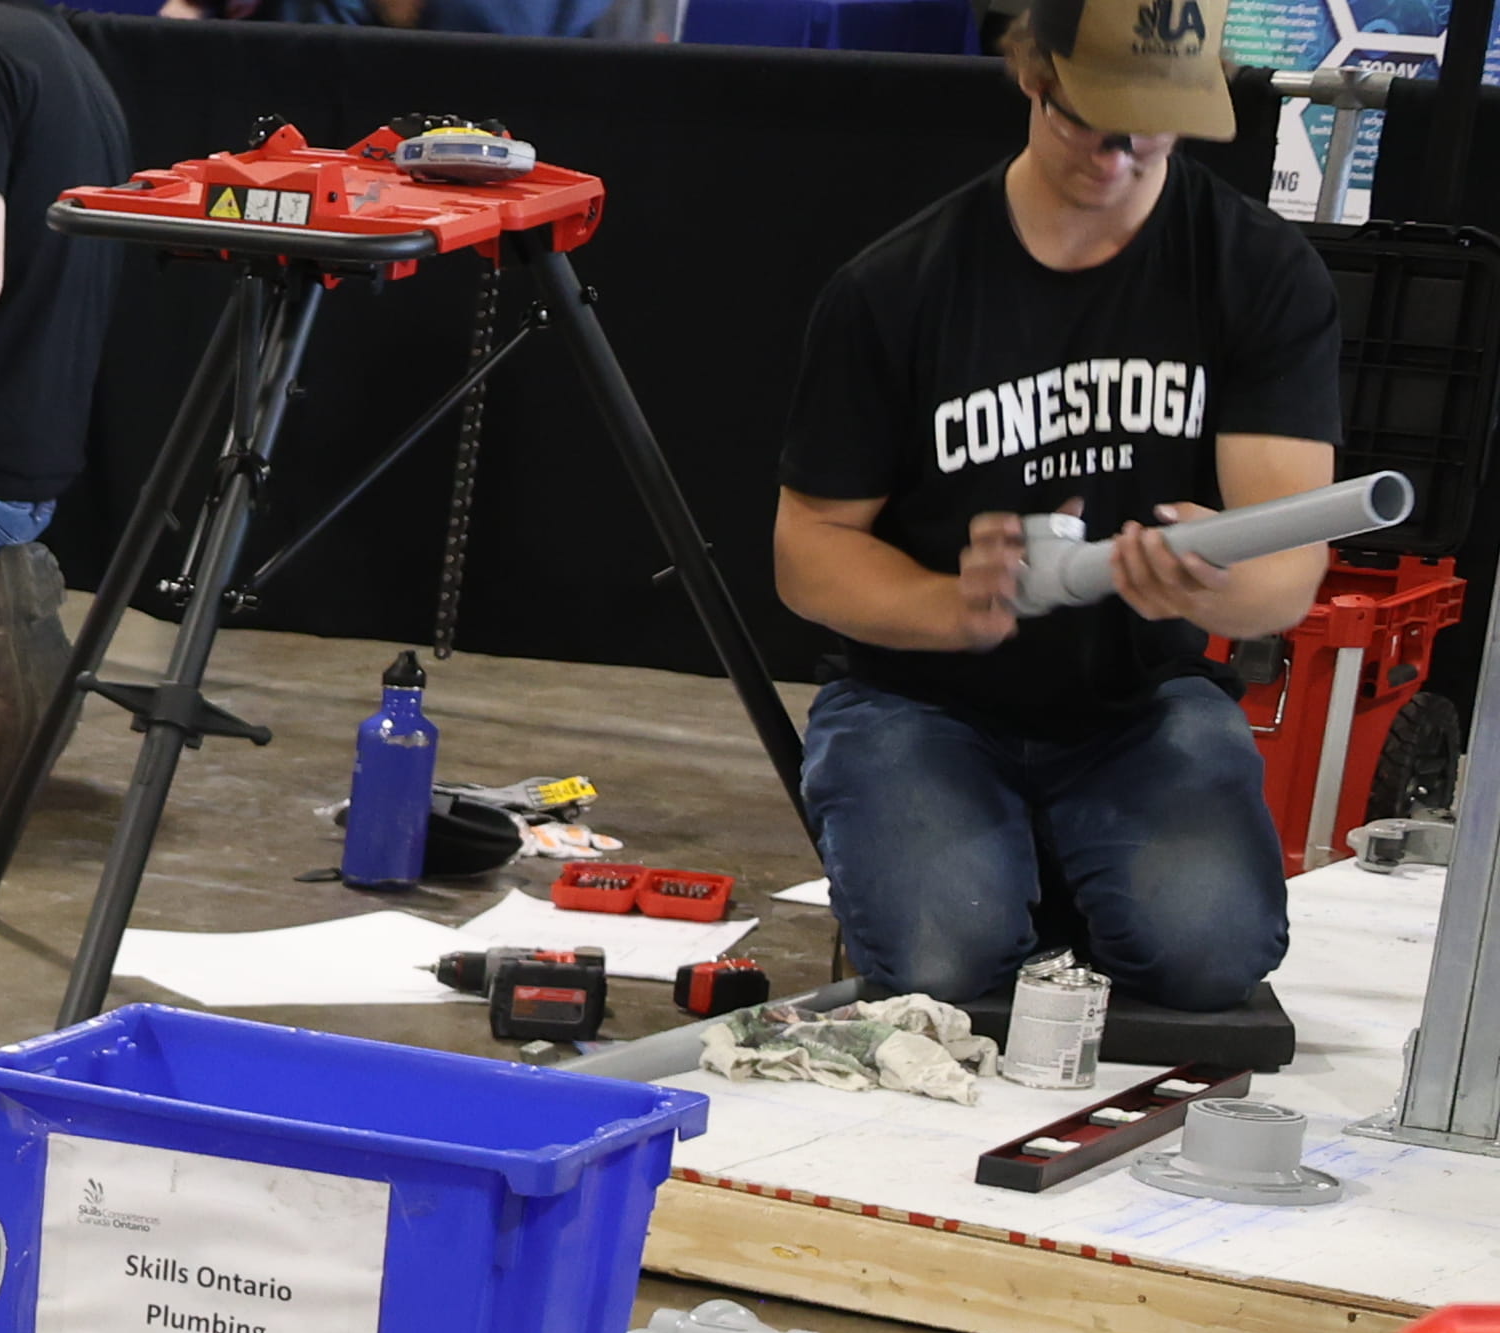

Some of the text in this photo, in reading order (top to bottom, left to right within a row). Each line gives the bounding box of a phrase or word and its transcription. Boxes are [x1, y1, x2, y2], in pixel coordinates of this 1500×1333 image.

[934, 357, 1207, 474] CONESTOGA
[1023, 443, 1134, 486] COLLEGE
[112, 1219, 151, 1233] Ontario
[125, 1254, 293, 1302] Skills Ontario
